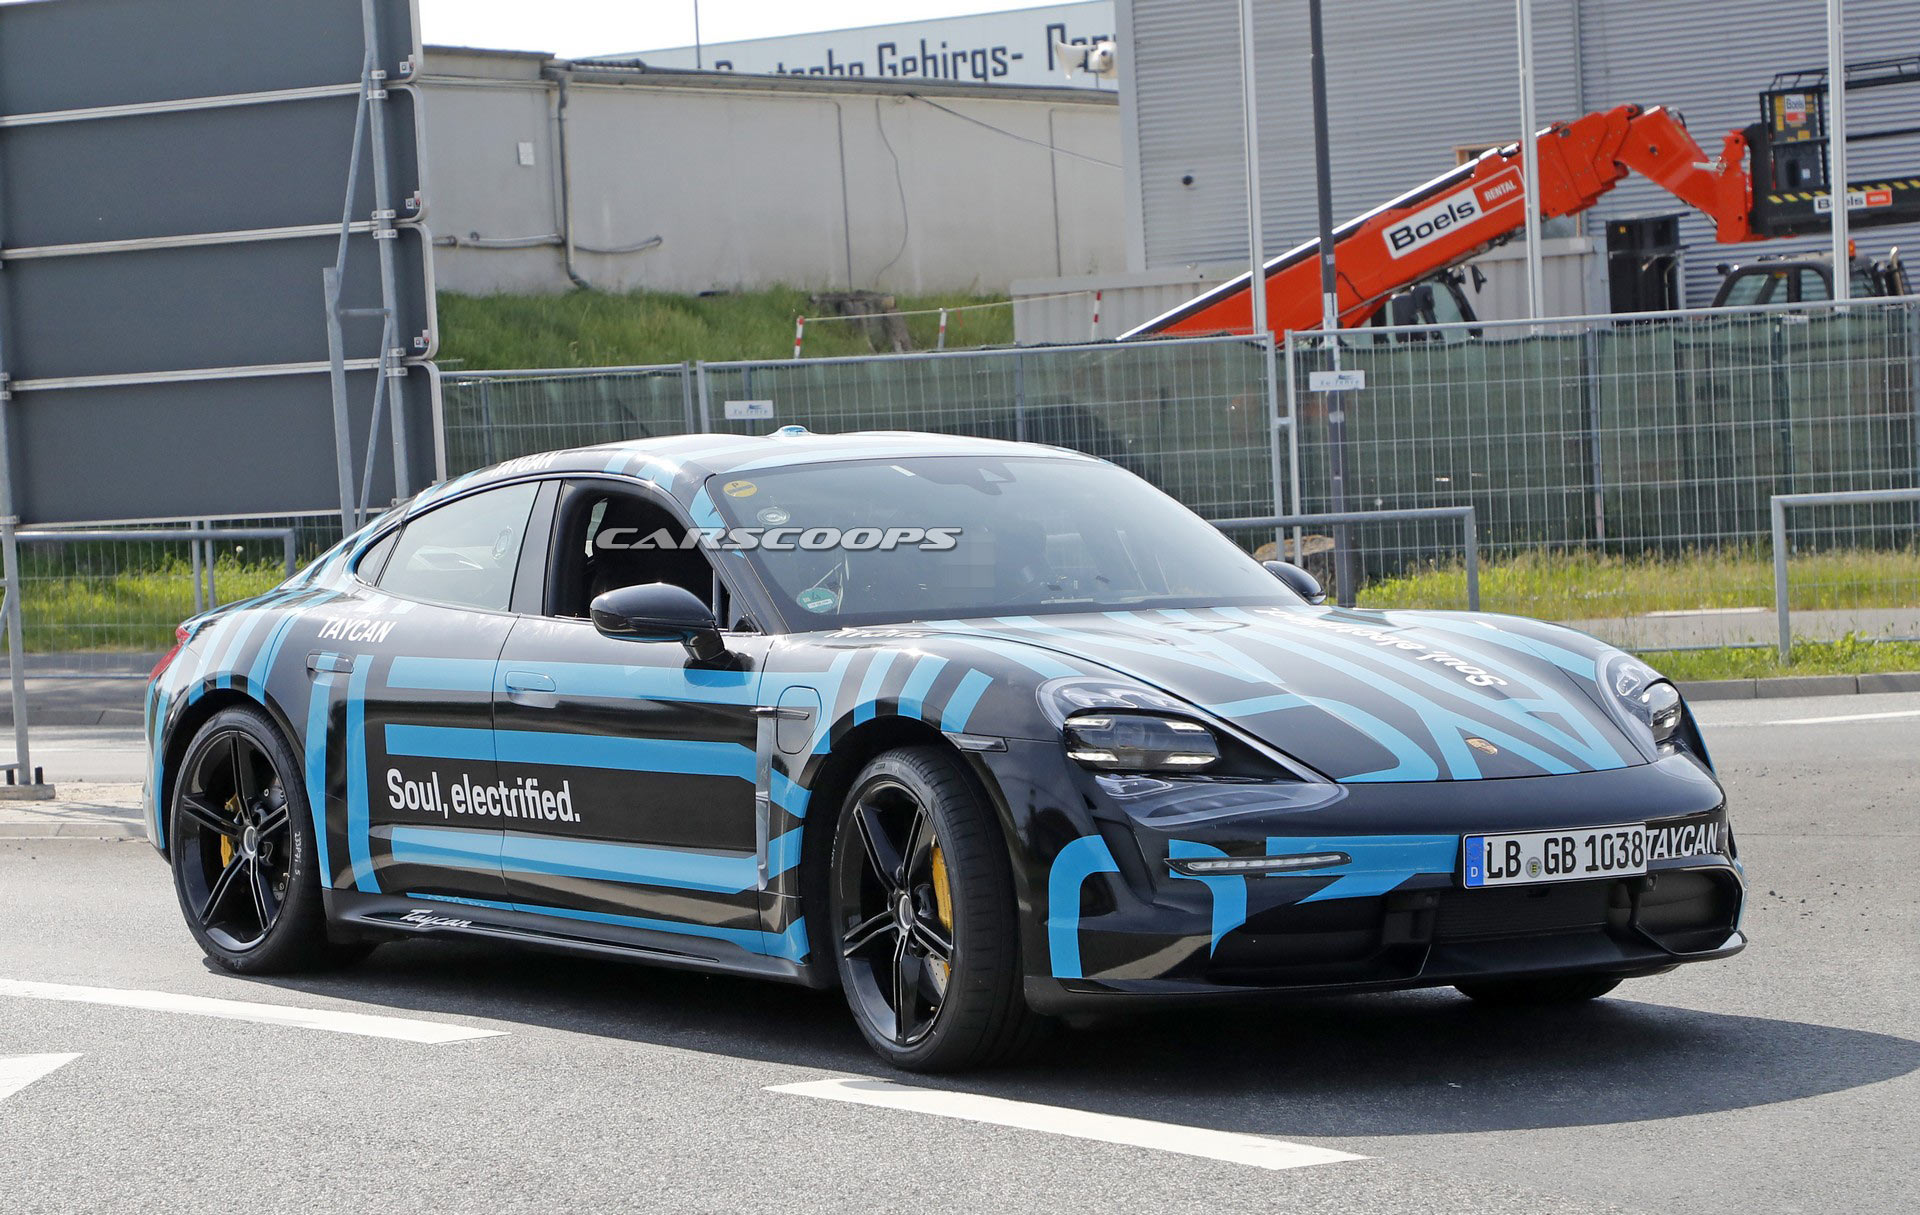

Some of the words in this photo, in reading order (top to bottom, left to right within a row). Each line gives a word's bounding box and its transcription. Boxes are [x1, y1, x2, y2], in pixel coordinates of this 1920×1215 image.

[1483, 180, 1518, 202] RENTAL
[1817, 195, 1864, 209] Bls
[1389, 201, 1476, 251] Boels
[317, 615, 397, 643] TAYCAN
[386, 768, 449, 819] Soul,
[451, 773, 581, 823] electrified.
[1486, 840, 1522, 879] LB
[1543, 836, 1577, 875] GB
[1584, 830, 1644, 872] 1038
[1646, 822, 1719, 860] TAYCAN
[1470, 866, 1479, 878] D
[400, 909, 473, 929] Taycan
